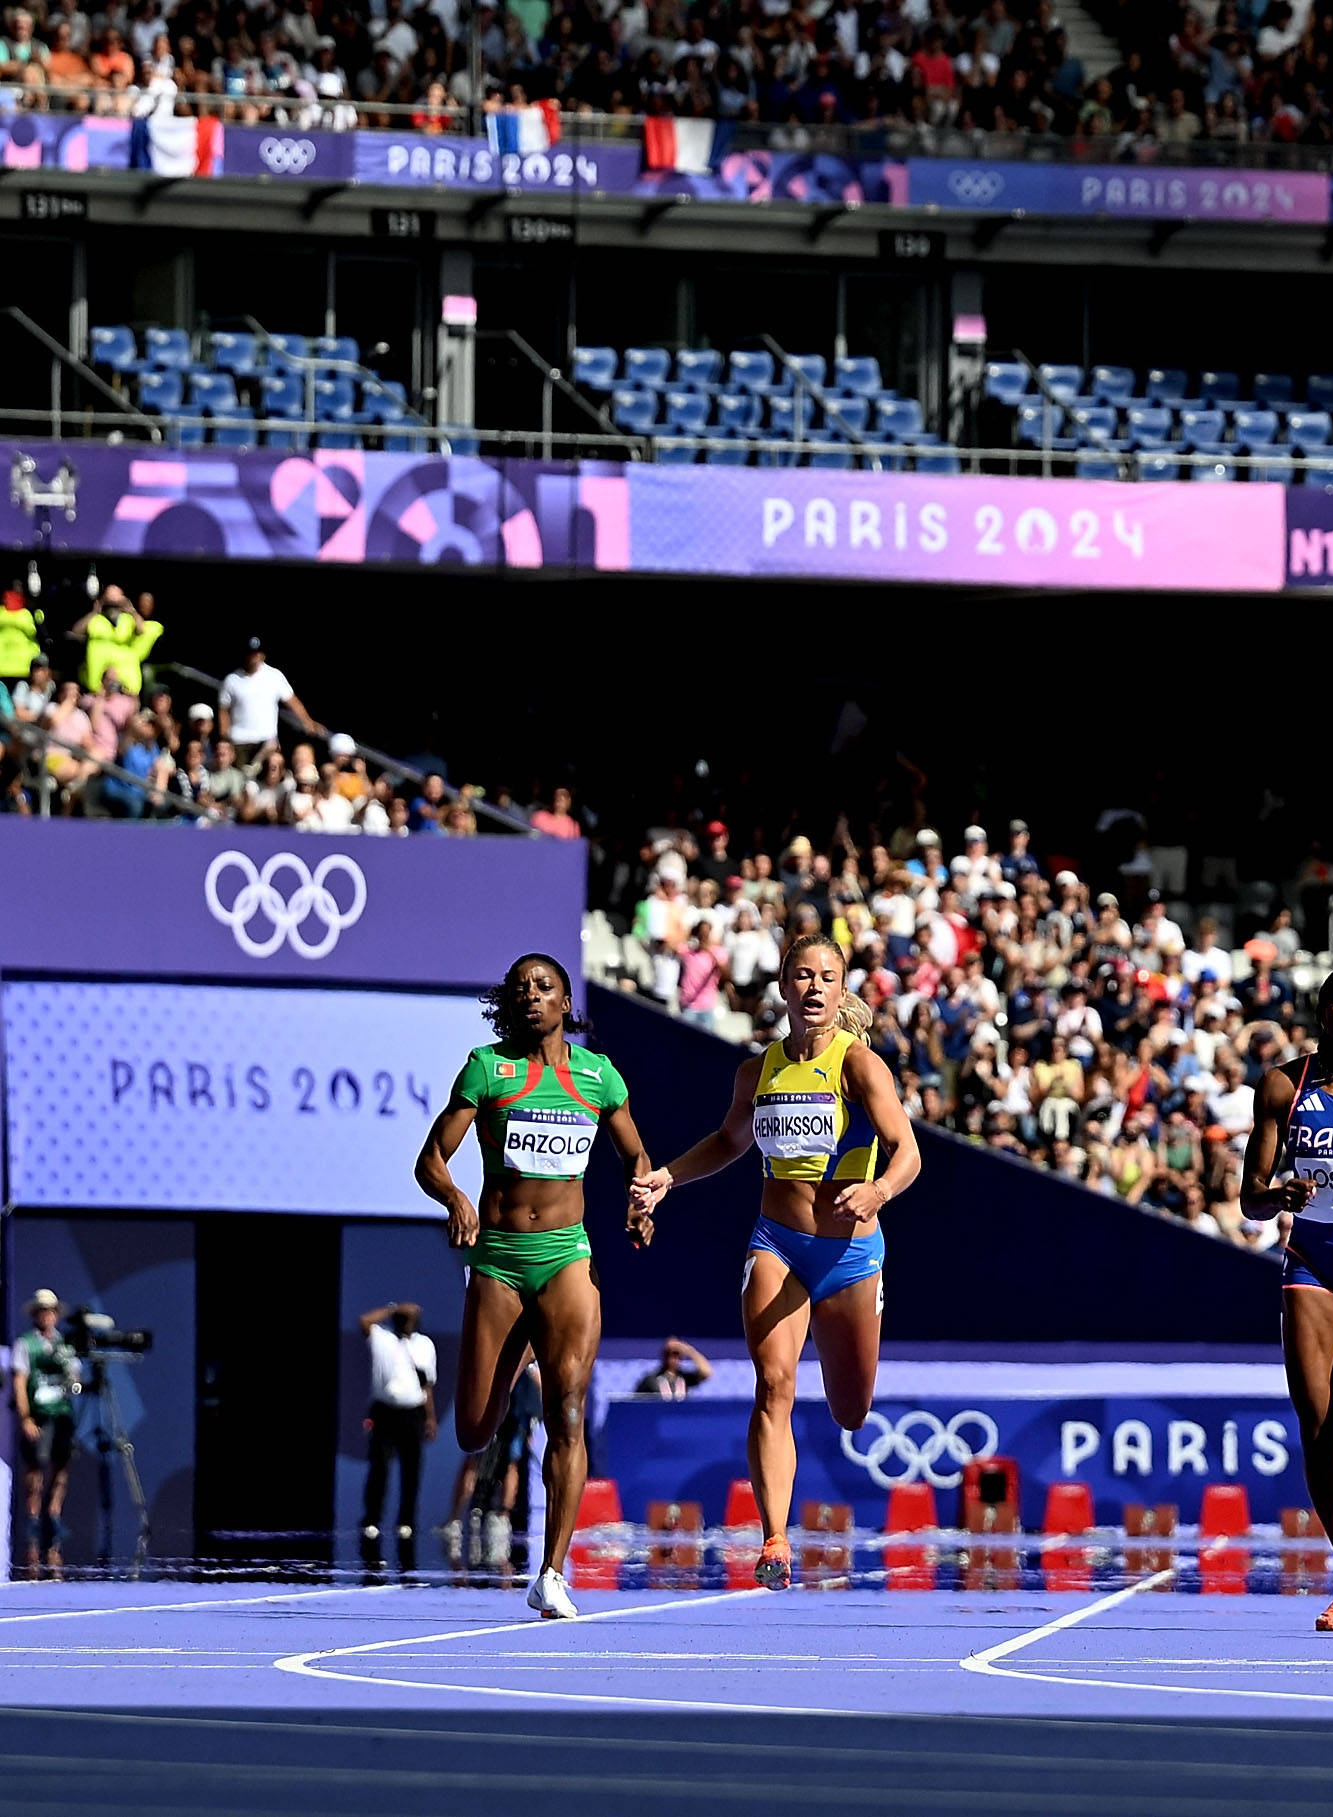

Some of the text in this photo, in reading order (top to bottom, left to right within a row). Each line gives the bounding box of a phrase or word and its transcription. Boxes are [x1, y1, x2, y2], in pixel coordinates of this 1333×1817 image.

[387, 145, 598, 187] PARIS 2024
[1081, 176, 1295, 212] PARIS 2024
[762, 498, 1144, 558] PARIS 2024
[110, 1058, 432, 1116] PARIS 2024
[507, 1132, 592, 1155] BAZOLO
[754, 1115, 834, 1138] HENRIKSSON
[1061, 1418, 1289, 1476] PARIS
